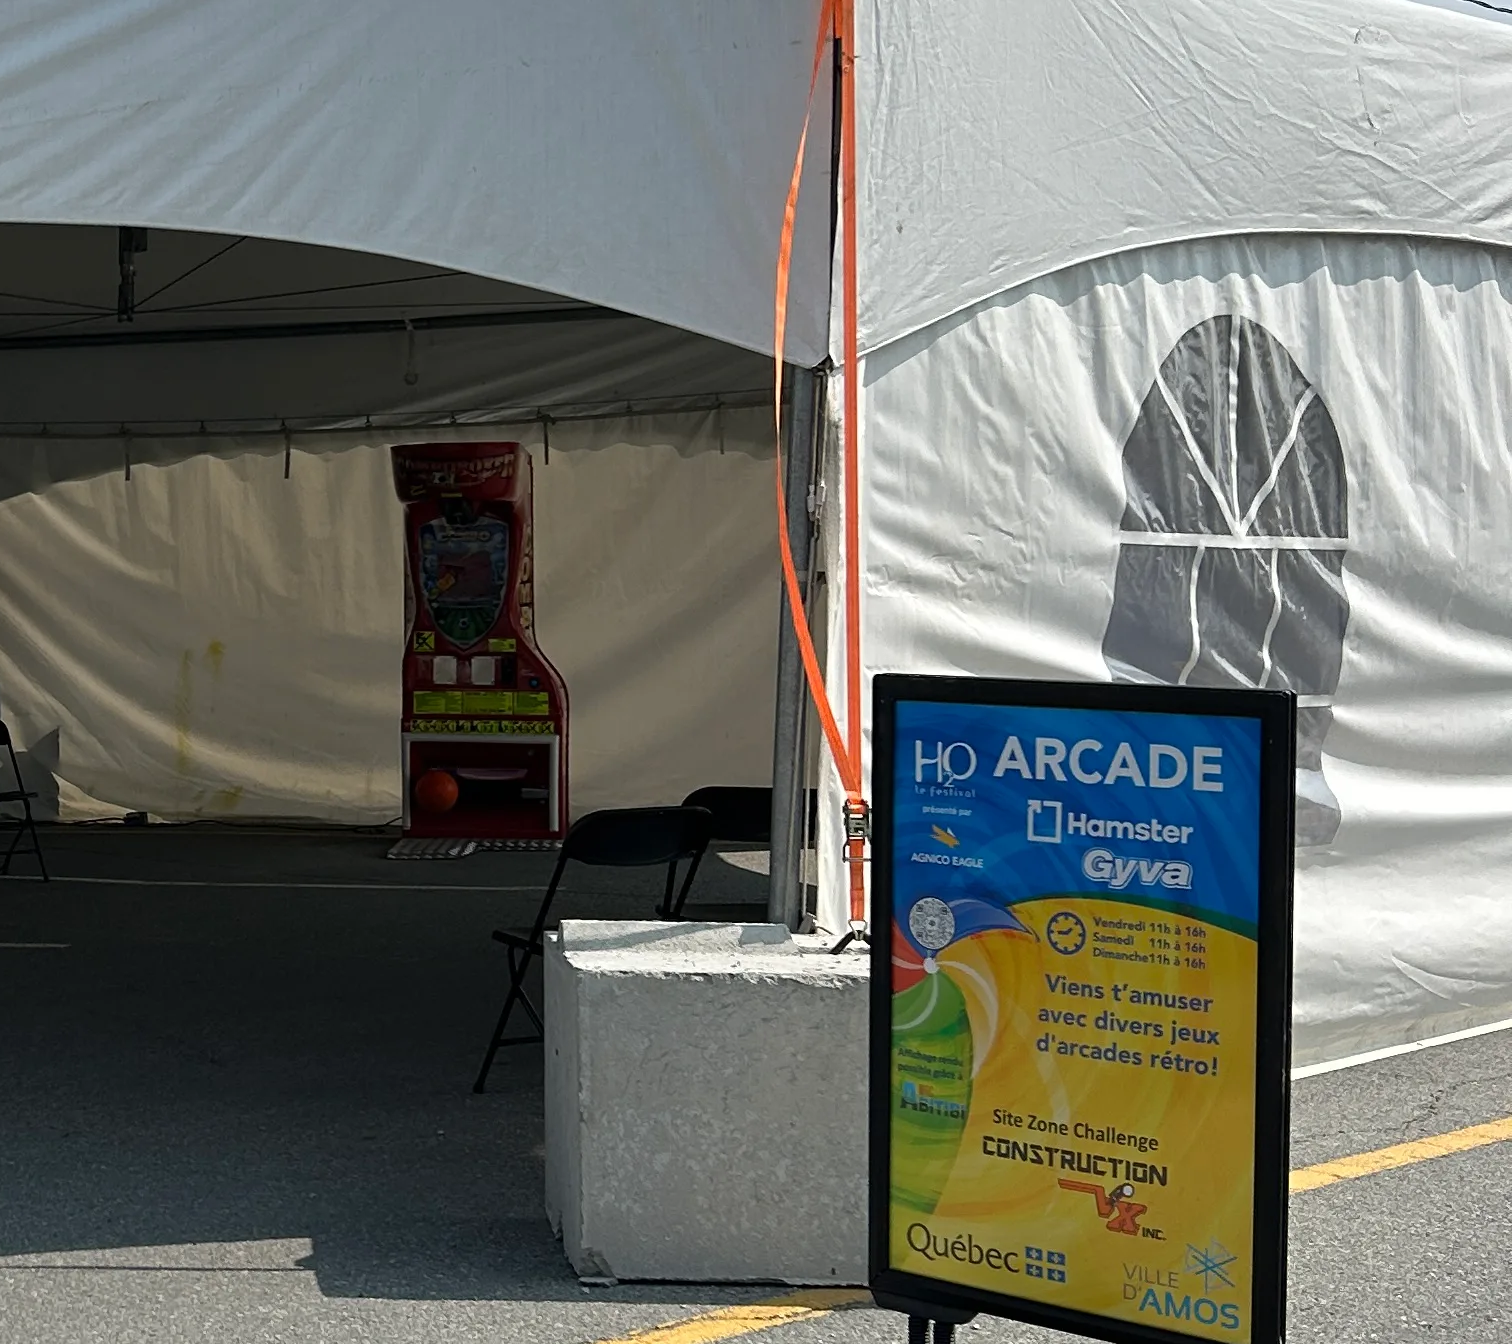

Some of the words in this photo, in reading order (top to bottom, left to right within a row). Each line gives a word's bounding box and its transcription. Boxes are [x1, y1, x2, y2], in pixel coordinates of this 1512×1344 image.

[992, 735, 1224, 793] ARCADE
[929, 786, 976, 799] festival
[958, 808, 973, 817] par
[1067, 811, 1194, 845] Hamster
[910, 852, 950, 866] AGNICO
[951, 855, 984, 869] EAGLE
[1081, 847, 1193, 890] Gyva
[1092, 915, 1146, 932] Vendredi
[1149, 922, 1171, 934] 11h
[1174, 924, 1182, 936] à
[1185, 925, 1207, 938] 16h
[1092, 931, 1134, 946] Samedi
[1149, 937, 1171, 950] 11h
[1174, 939, 1181, 951] à
[1185, 941, 1206, 954] 16h
[1092, 946, 1149, 963] Dimanche
[1149, 953, 1170, 966] 11h
[1173, 955, 1181, 967] à
[1184, 957, 1206, 970] 16h
[1044, 973, 1105, 1000] Viens
[1111, 983, 1214, 1013] t'amuser
[1037, 1007, 1088, 1028] avec
[1094, 1009, 1164, 1038] divers
[1170, 1020, 1221, 1046] jeux
[1035, 1032, 1143, 1066] d'arcades
[1149, 1050, 1218, 1077] rétro!
[992, 1108, 1023, 1129] Site
[1027, 1114, 1069, 1136] Zone
[1073, 1121, 1160, 1154] Challenge
[981, 1135, 1169, 1187] CONSTRUCTION
[905, 1222, 1020, 1274] Québec
[1142, 1226, 1168, 1242] INC.
[1122, 1262, 1180, 1289] VILLE
[1123, 1283, 1240, 1330] D'AMOS
